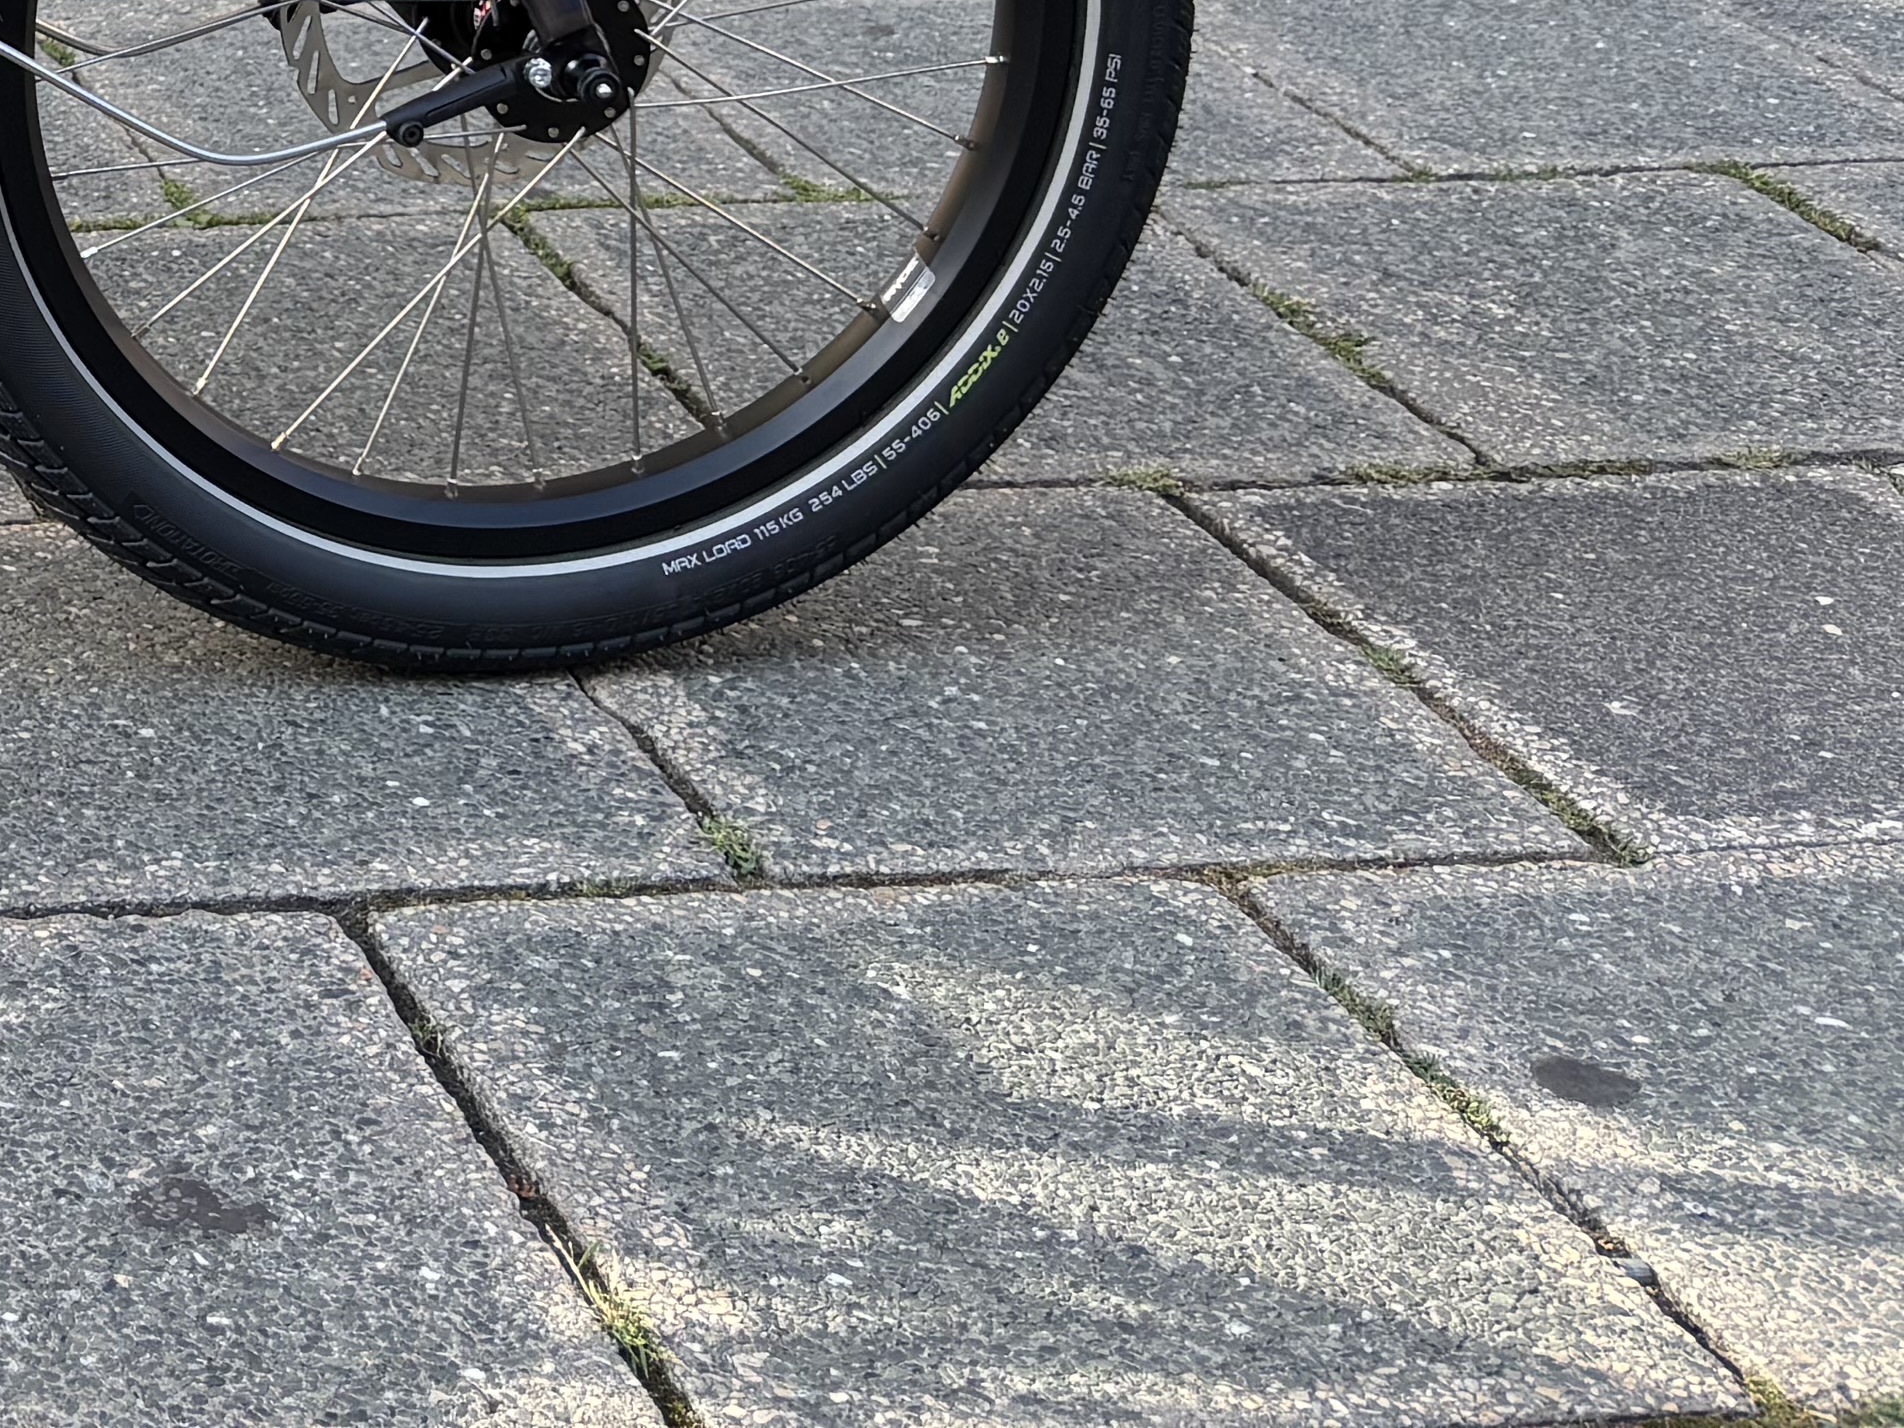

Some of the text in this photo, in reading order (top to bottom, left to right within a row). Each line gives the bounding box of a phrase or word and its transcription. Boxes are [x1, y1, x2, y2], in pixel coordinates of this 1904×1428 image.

[660, 551, 701, 577] MAX
[699, 531, 753, 564] LOAD
[752, 518, 781, 542] 115
[777, 505, 805, 529] KG
[806, 483, 844, 513] 254
[839, 459, 880, 492] LBS
[879, 405, 942, 463] 55-406
[1048, 191, 1086, 254] 2.5-4.5
[1076, 148, 1101, 190] BAR
[1090, 86, 1116, 141] 35-65
[1103, 52, 1122, 82] PSI
